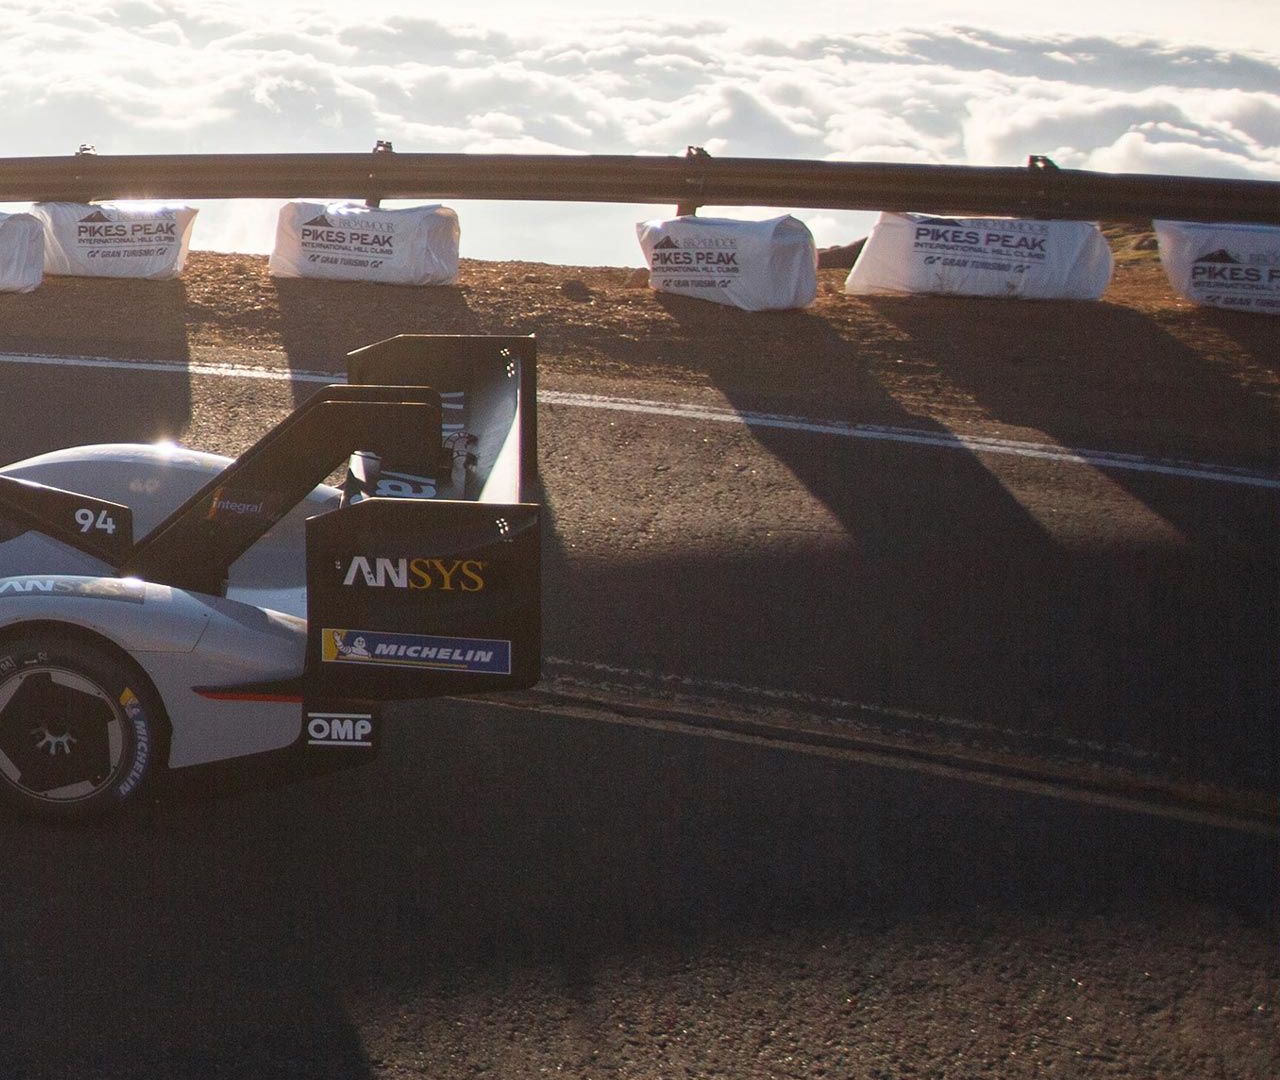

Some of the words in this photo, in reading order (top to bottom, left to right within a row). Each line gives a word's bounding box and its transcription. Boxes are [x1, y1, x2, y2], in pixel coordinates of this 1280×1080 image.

[78, 225, 126, 236] PIKES
[132, 224, 175, 235] PEAK
[302, 229, 345, 243] PIKES
[350, 233, 392, 247] PEAK
[916, 228, 979, 244] PIKES
[985, 234, 1046, 251] PEAK
[652, 252, 692, 265] PIKES
[696, 252, 737, 264] PEAK
[1192, 266, 1261, 281] PIKES
[212, 497, 264, 513] integral
[74, 508, 116, 535] 94
[343, 556, 486, 591] ANSYS
[375, 643, 493, 663] MICHELIN
[307, 718, 372, 741] OMP
[119, 720, 149, 796] MICHELIN
